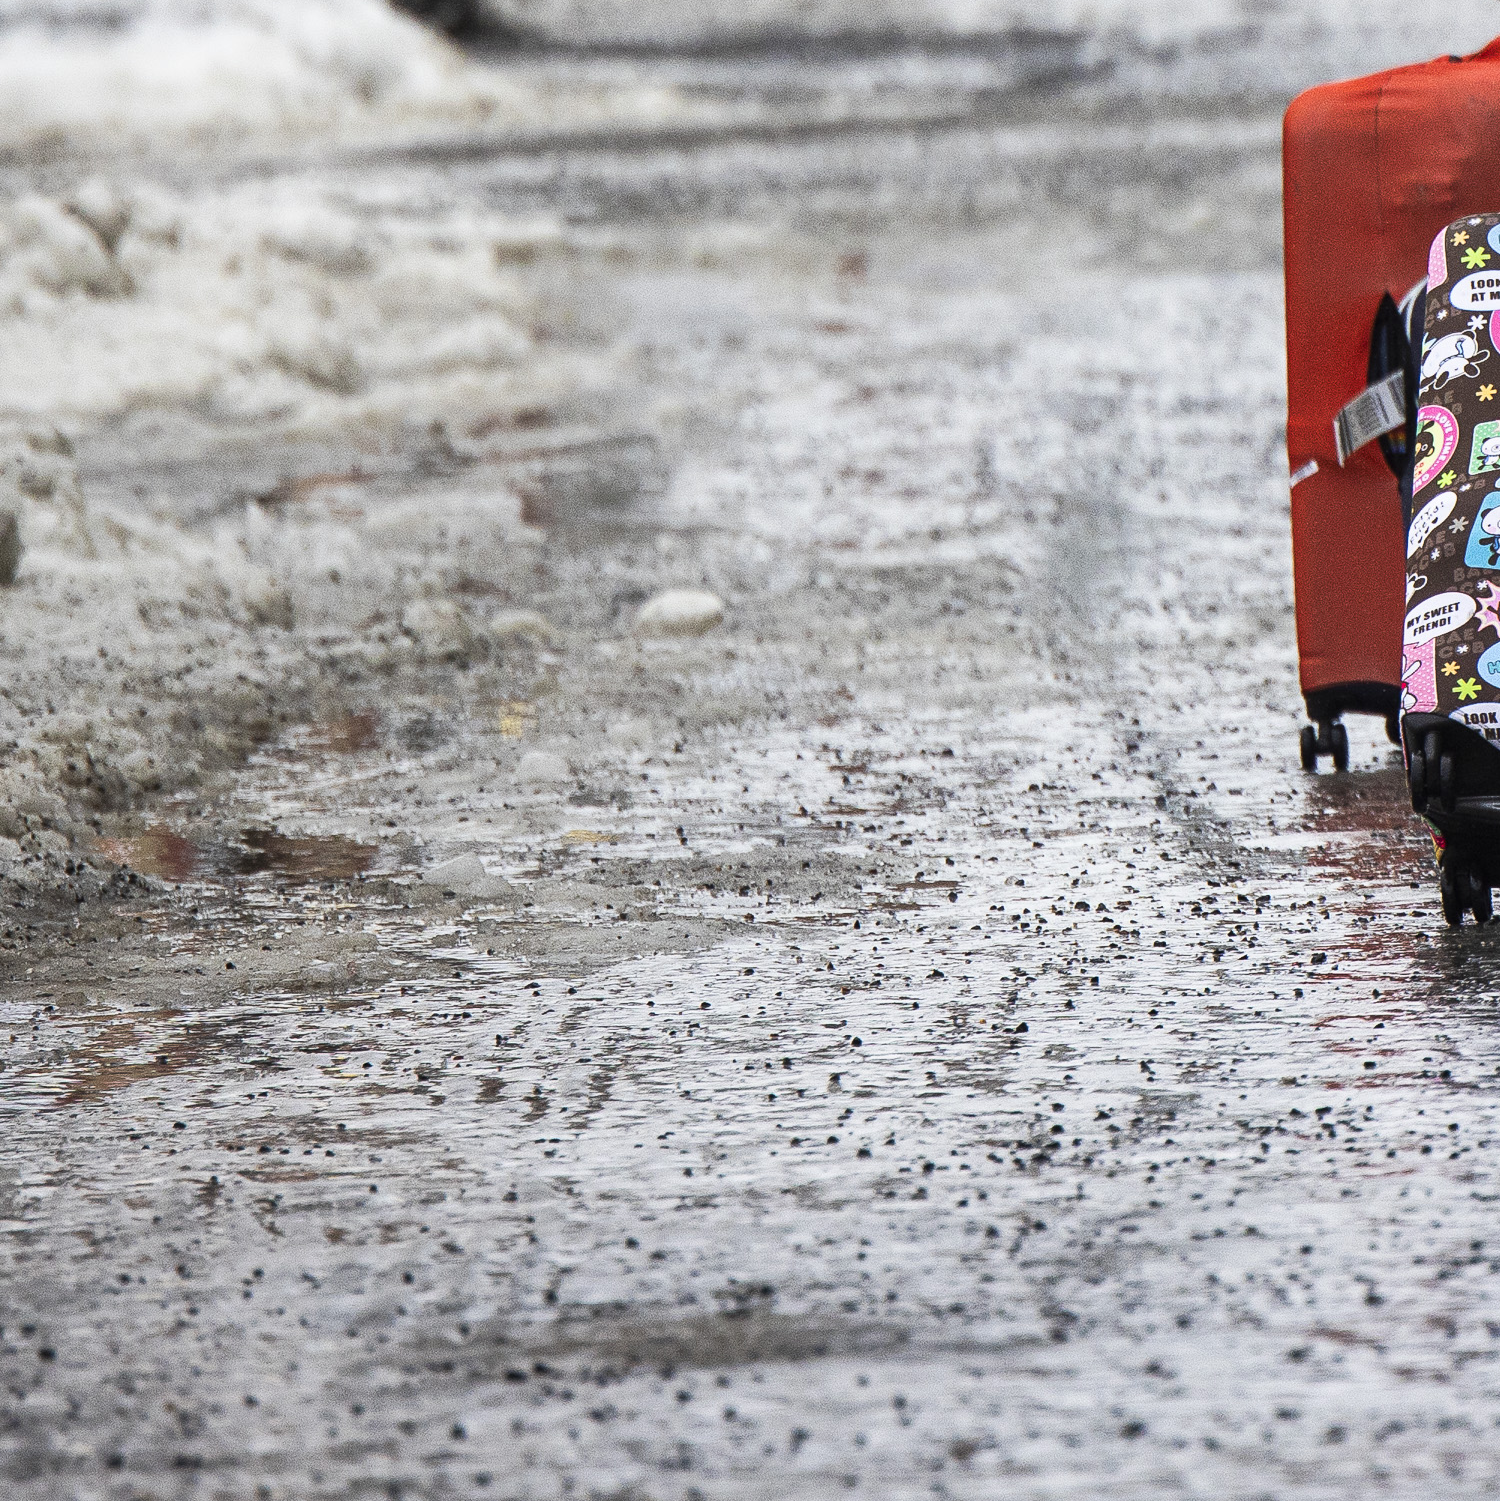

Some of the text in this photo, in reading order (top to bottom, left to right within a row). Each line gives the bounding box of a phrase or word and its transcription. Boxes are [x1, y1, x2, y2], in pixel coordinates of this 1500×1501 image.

[1471, 292, 1486, 302] AT
[1435, 411, 1454, 435] LOVE
[1406, 601, 1461, 630] MY SWEET
[1463, 711, 1499, 725] LOOK
